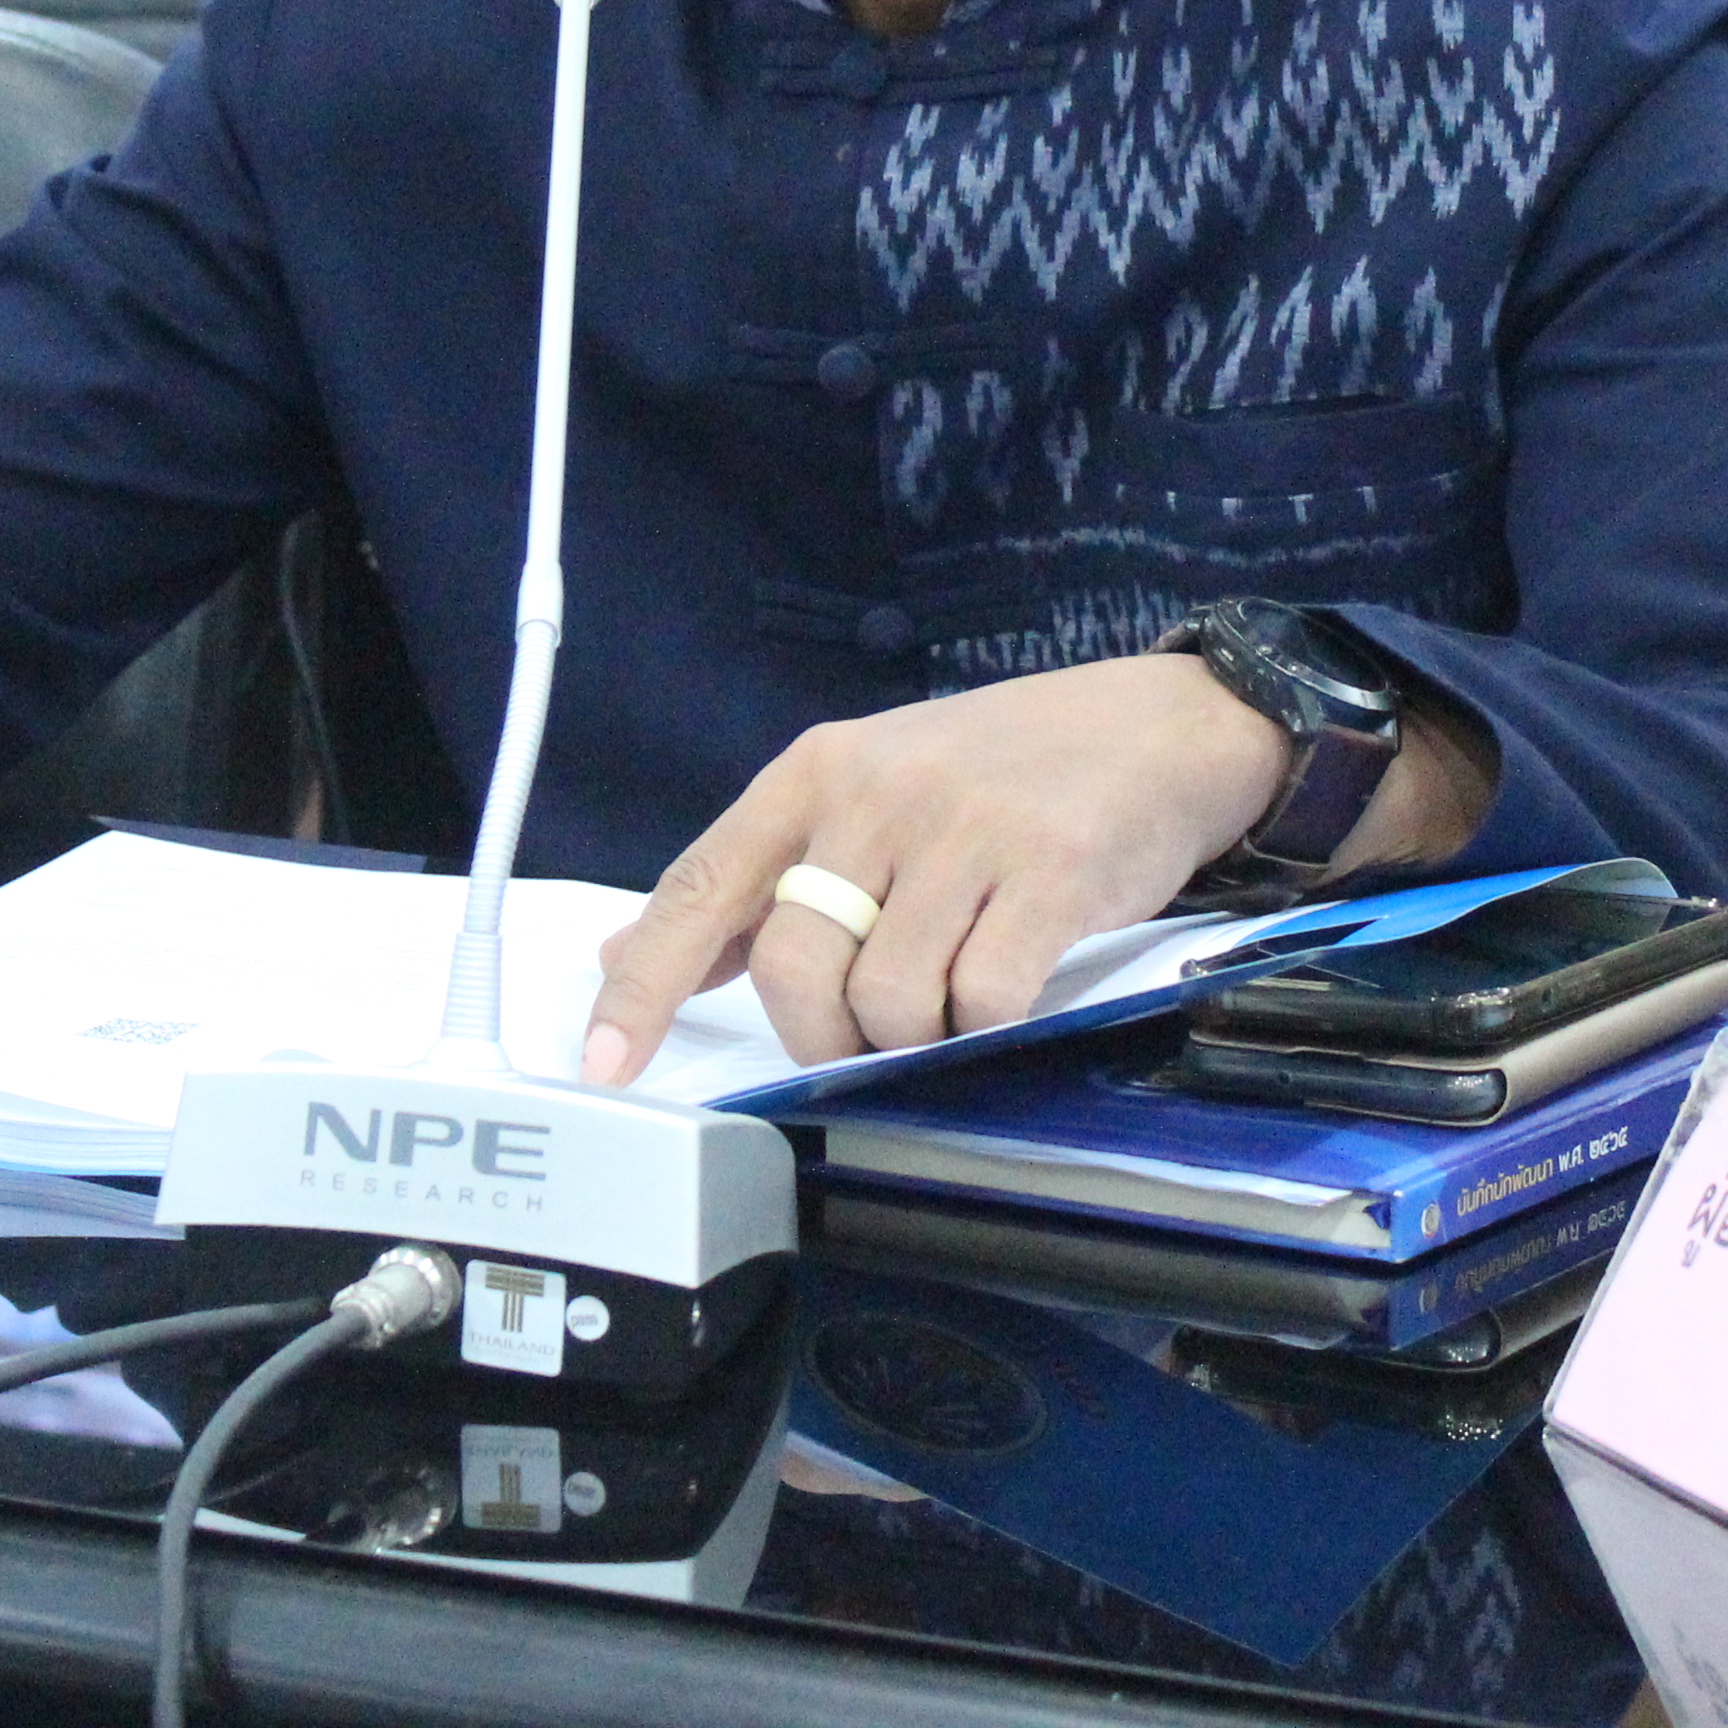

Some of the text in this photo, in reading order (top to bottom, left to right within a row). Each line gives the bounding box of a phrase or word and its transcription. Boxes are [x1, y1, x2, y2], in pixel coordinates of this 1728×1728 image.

[304, 1101, 551, 1182] NPE
[299, 1170, 543, 1212] RESEARCH
[469, 1332, 556, 1357] THAILAND
